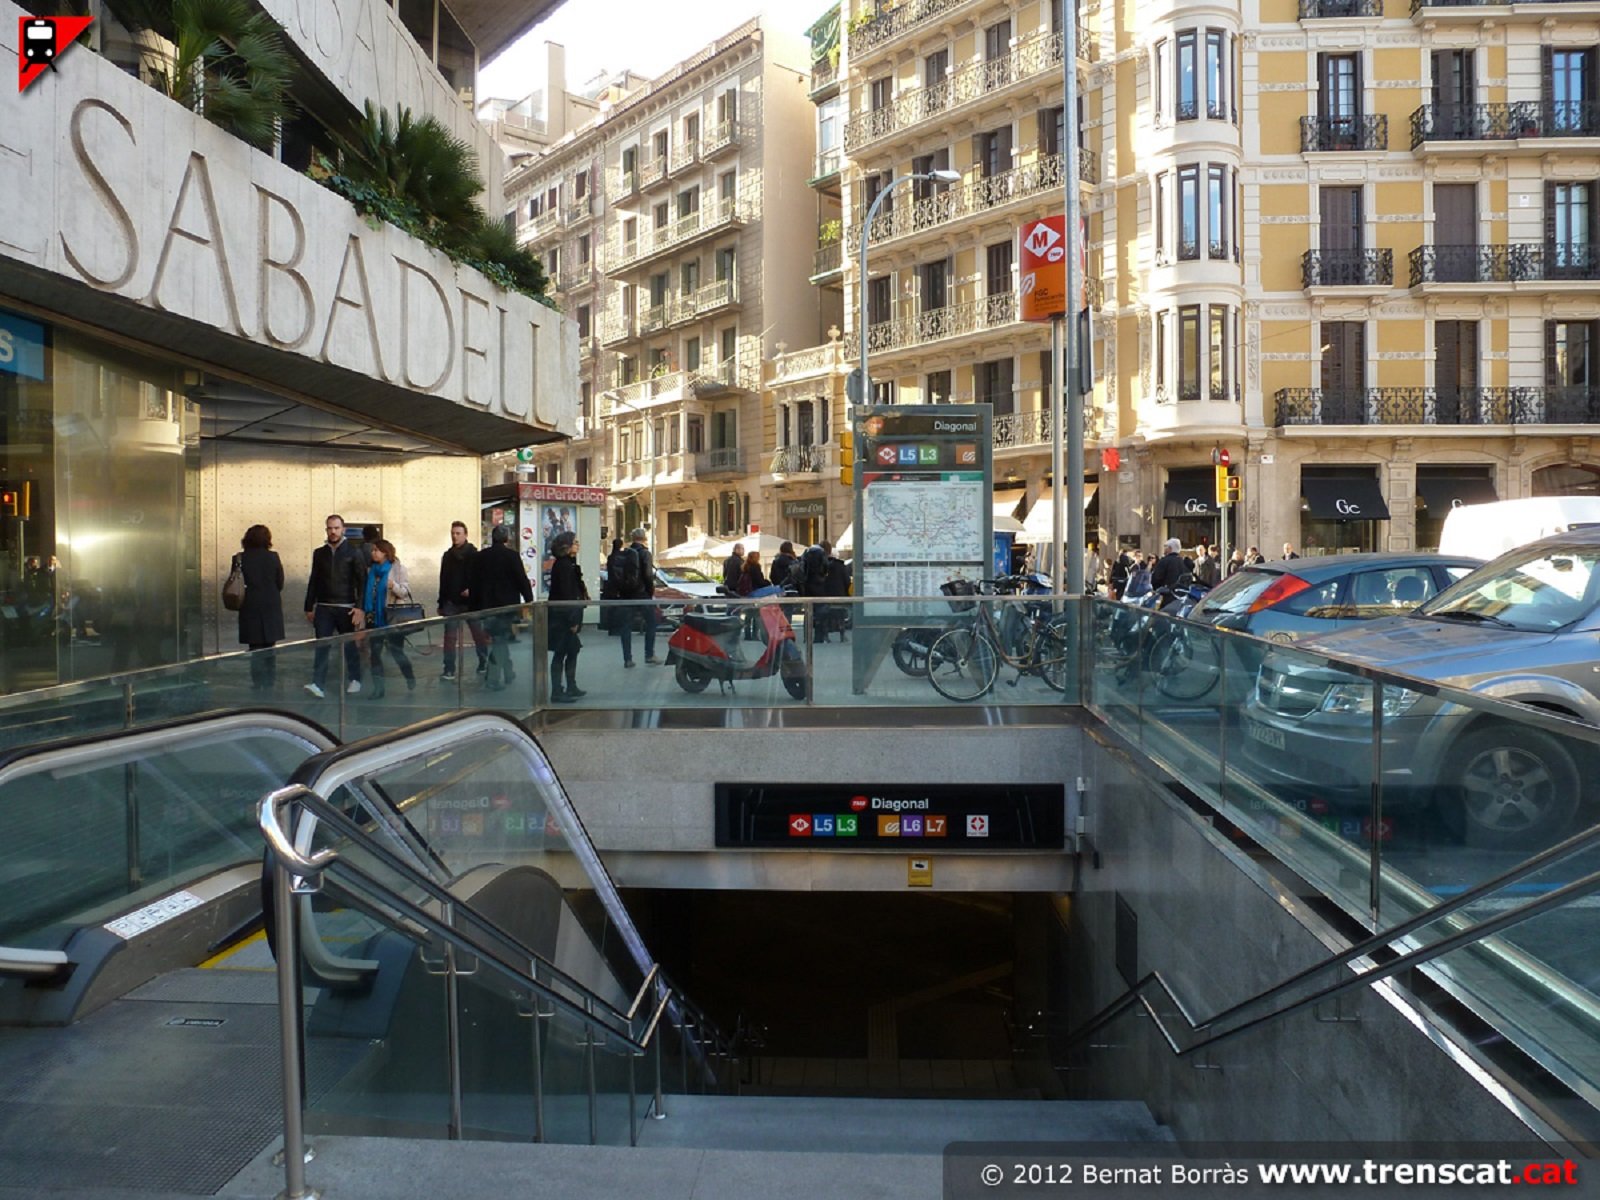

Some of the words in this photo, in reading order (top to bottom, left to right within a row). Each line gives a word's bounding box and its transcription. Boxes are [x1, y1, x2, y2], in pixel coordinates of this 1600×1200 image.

[59, 97, 562, 428] SABADELL
[934, 420, 977, 433] Diagonal
[899, 448, 916, 461] L5
[920, 448, 937, 461] L3
[534, 487, 545, 500] el
[546, 487, 605, 503] Periódico
[1184, 498, 1208, 513] Gc
[1336, 498, 1361, 514] Gc
[871, 798, 929, 811] Diagonal
[814, 819, 833, 832] L5
[837, 819, 856, 832] L3
[903, 819, 921, 832] L6
[926, 819, 945, 832] L7
